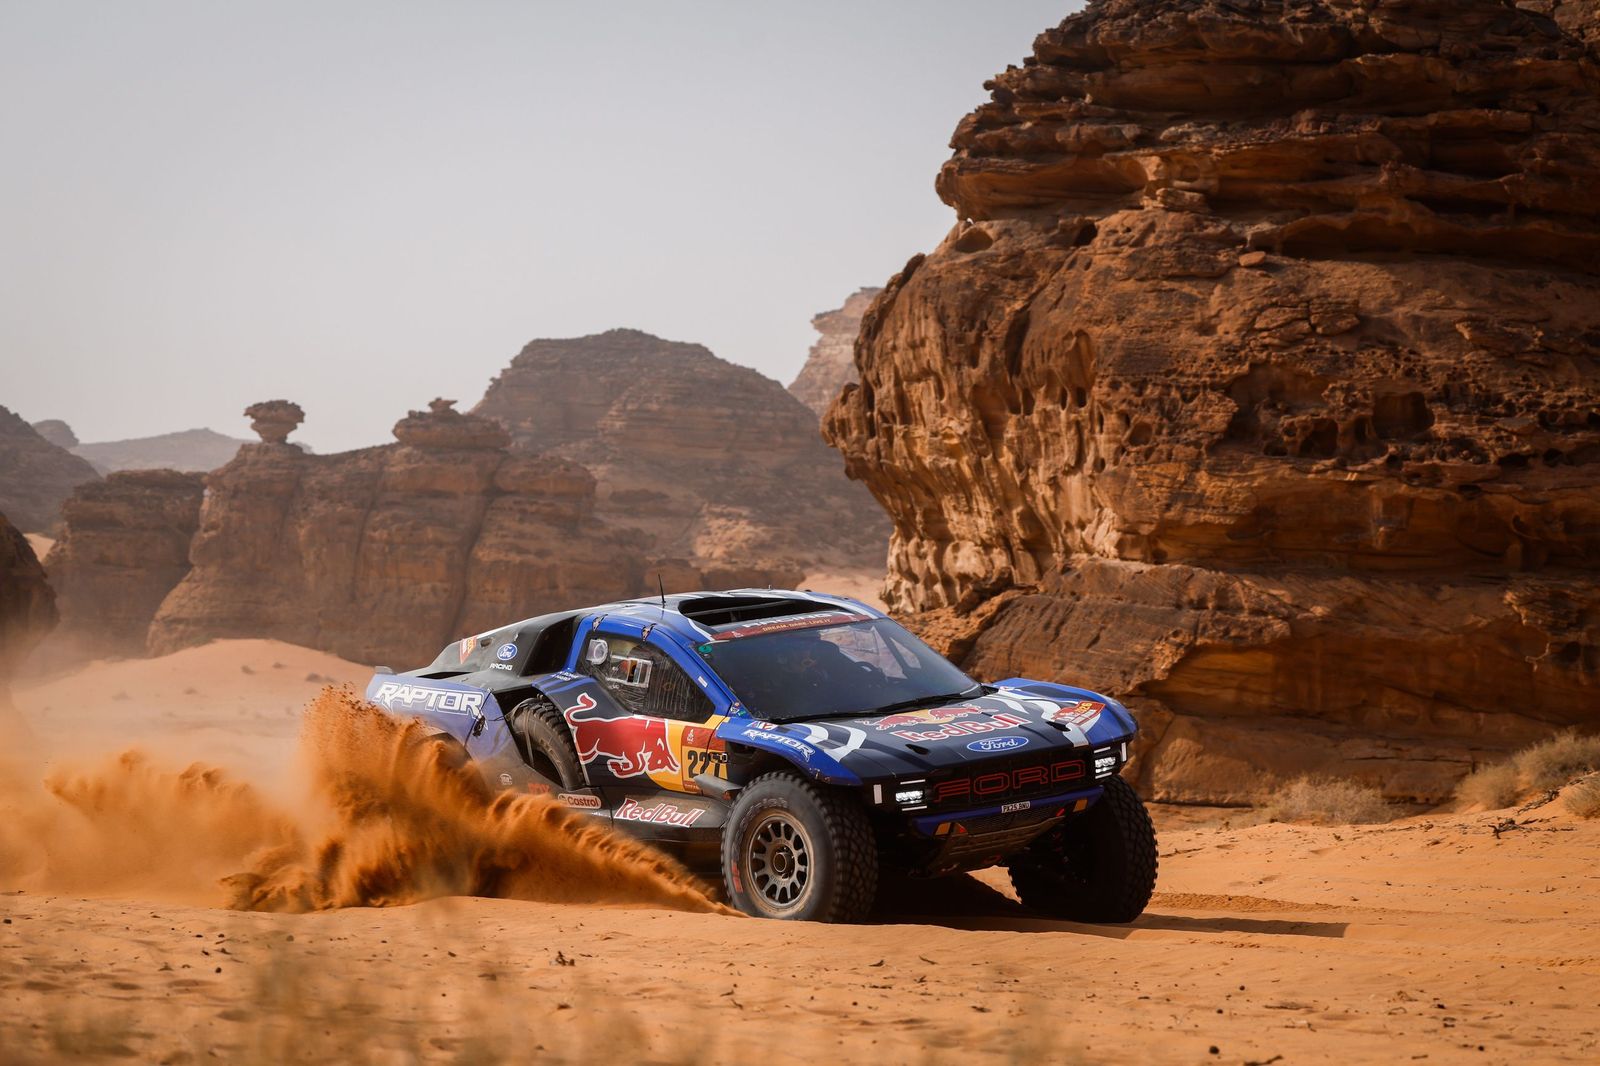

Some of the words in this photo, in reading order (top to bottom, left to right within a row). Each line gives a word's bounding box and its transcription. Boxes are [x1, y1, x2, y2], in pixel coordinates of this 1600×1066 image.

[489, 662, 513, 671] RACING
[373, 682, 484, 719] RAPTOR
[741, 729, 815, 762] RAPTOR
[933, 760, 1085, 803] FORD
[567, 796, 599, 808] Castrol
